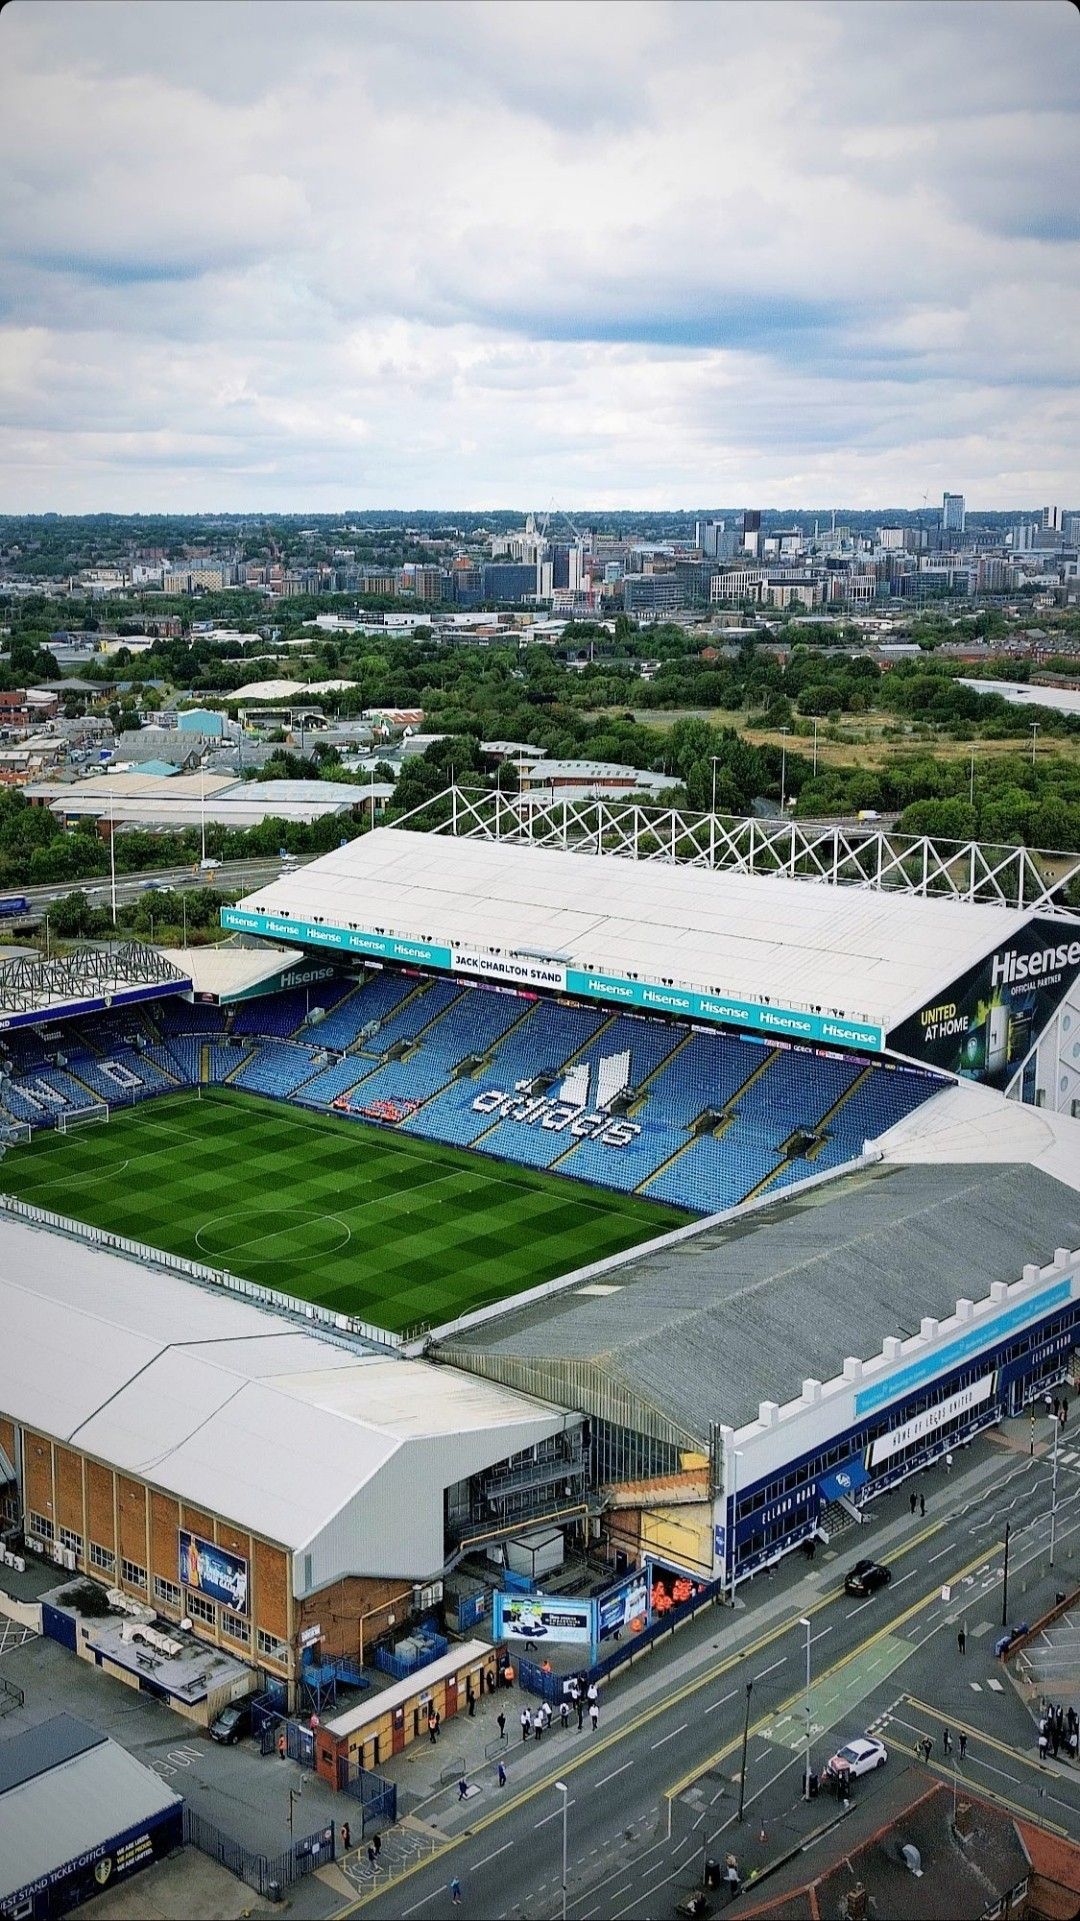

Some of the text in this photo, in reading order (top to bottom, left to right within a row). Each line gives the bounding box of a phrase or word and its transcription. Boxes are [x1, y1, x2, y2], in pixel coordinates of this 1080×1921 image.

[226, 914, 259, 928] Hisense
[265, 920, 299, 935] Hisense
[306, 928, 342, 943] Hisense
[349, 936, 386, 952] Hisense
[393, 944, 432, 960] Hisense
[455, 955, 562, 983] JACK CHARLTON STAND
[991, 941, 1080, 986] Hisense
[281, 967, 334, 987] Hisense
[1010, 973, 1061, 996] OFFICIAL PARTNER
[588, 980, 633, 997] Hisense
[642, 989, 689, 1008] Hisense
[700, 1000, 749, 1020] Hisense
[920, 1003, 957, 1026] UNITED
[760, 1011, 811, 1031] Hisense
[924, 1016, 969, 1042] AT HOME
[822, 1023, 877, 1044] Hisense
[892, 1428, 911, 1446] HOME
[949, 1391, 973, 1413] UNITED
[762, 1483, 816, 1525] ELLAND ROAD
[167, 1744, 205, 1767] NO
[19, 1879, 48, 1901] STAND
[50, 1860, 78, 1883] TICKET
[78, 1845, 106, 1868] OFFICE
